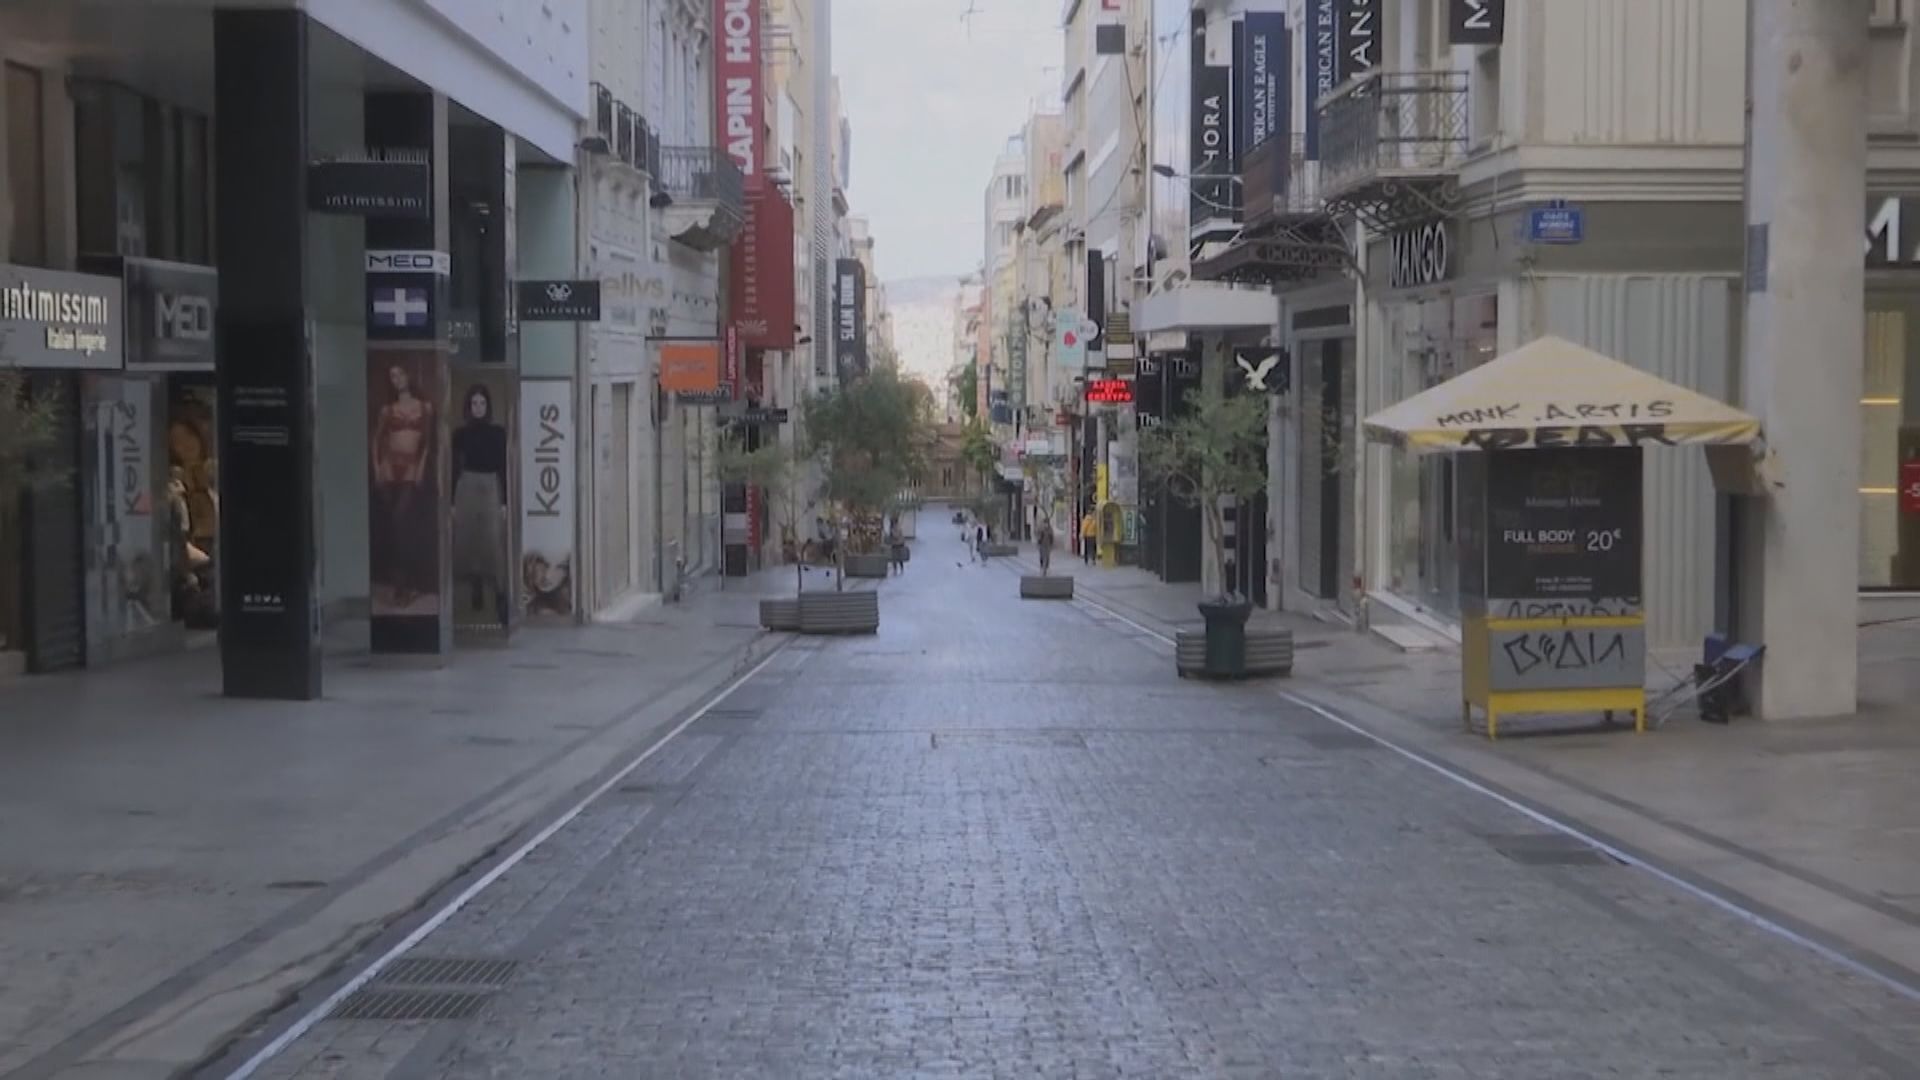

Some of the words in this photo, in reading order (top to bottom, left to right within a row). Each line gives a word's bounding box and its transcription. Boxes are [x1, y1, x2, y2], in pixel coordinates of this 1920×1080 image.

[1253, 35, 1266, 84] EAGLE
[1349, 0, 1371, 98] MAN
[727, 78, 754, 175] LAPIN
[1204, 97, 1219, 161] HORA
[1253, 84, 1266, 146] ERICAN
[1390, 221, 1447, 287] MANGO
[1864, 197, 1920, 262] M
[3, 280, 108, 324] intimissimi
[602, 272, 663, 300] ellys
[1437, 403, 1520, 427] MONK
[527, 403, 564, 518] kellys
[1503, 530, 1535, 543] FULL
[1538, 530, 1576, 543] BODY
